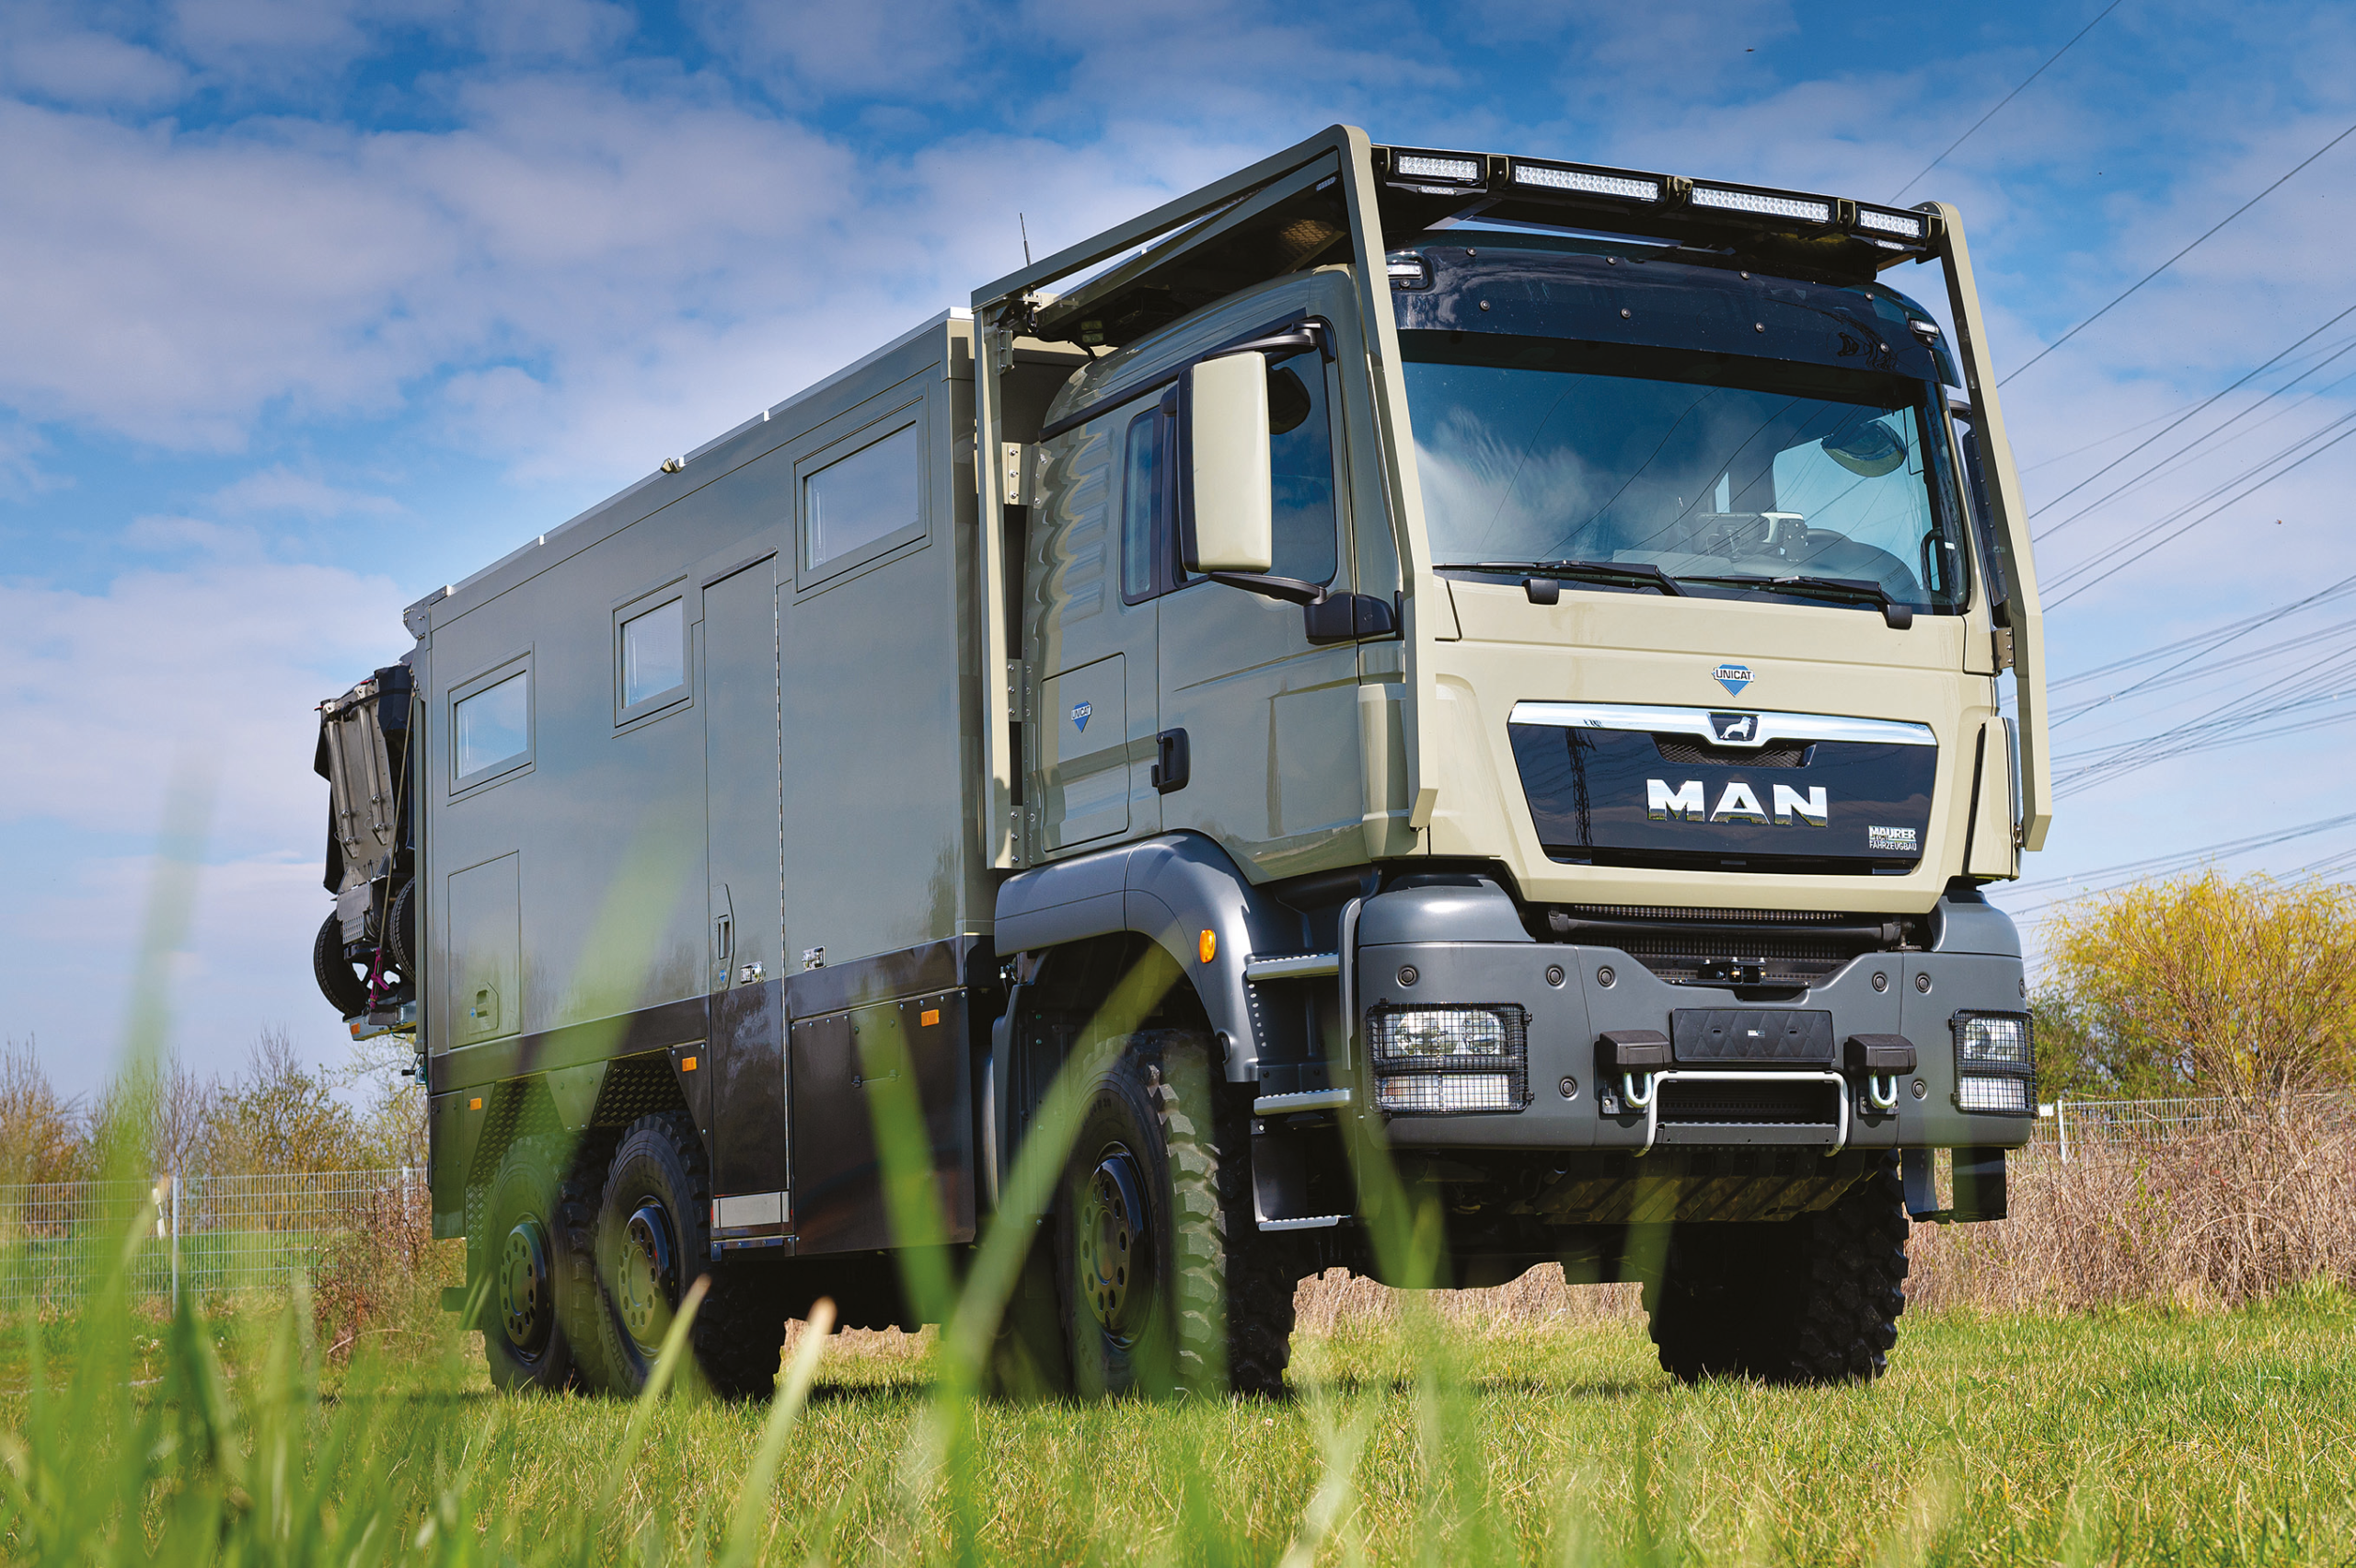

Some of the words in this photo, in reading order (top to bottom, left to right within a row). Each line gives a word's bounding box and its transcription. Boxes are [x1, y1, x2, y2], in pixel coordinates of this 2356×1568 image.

[1715, 669, 1752, 680] UNICAT
[1646, 778, 1828, 827] MAN
[1868, 825, 1916, 839] MAURER
[1869, 839, 1917, 851] FAHRZEUGBAU
